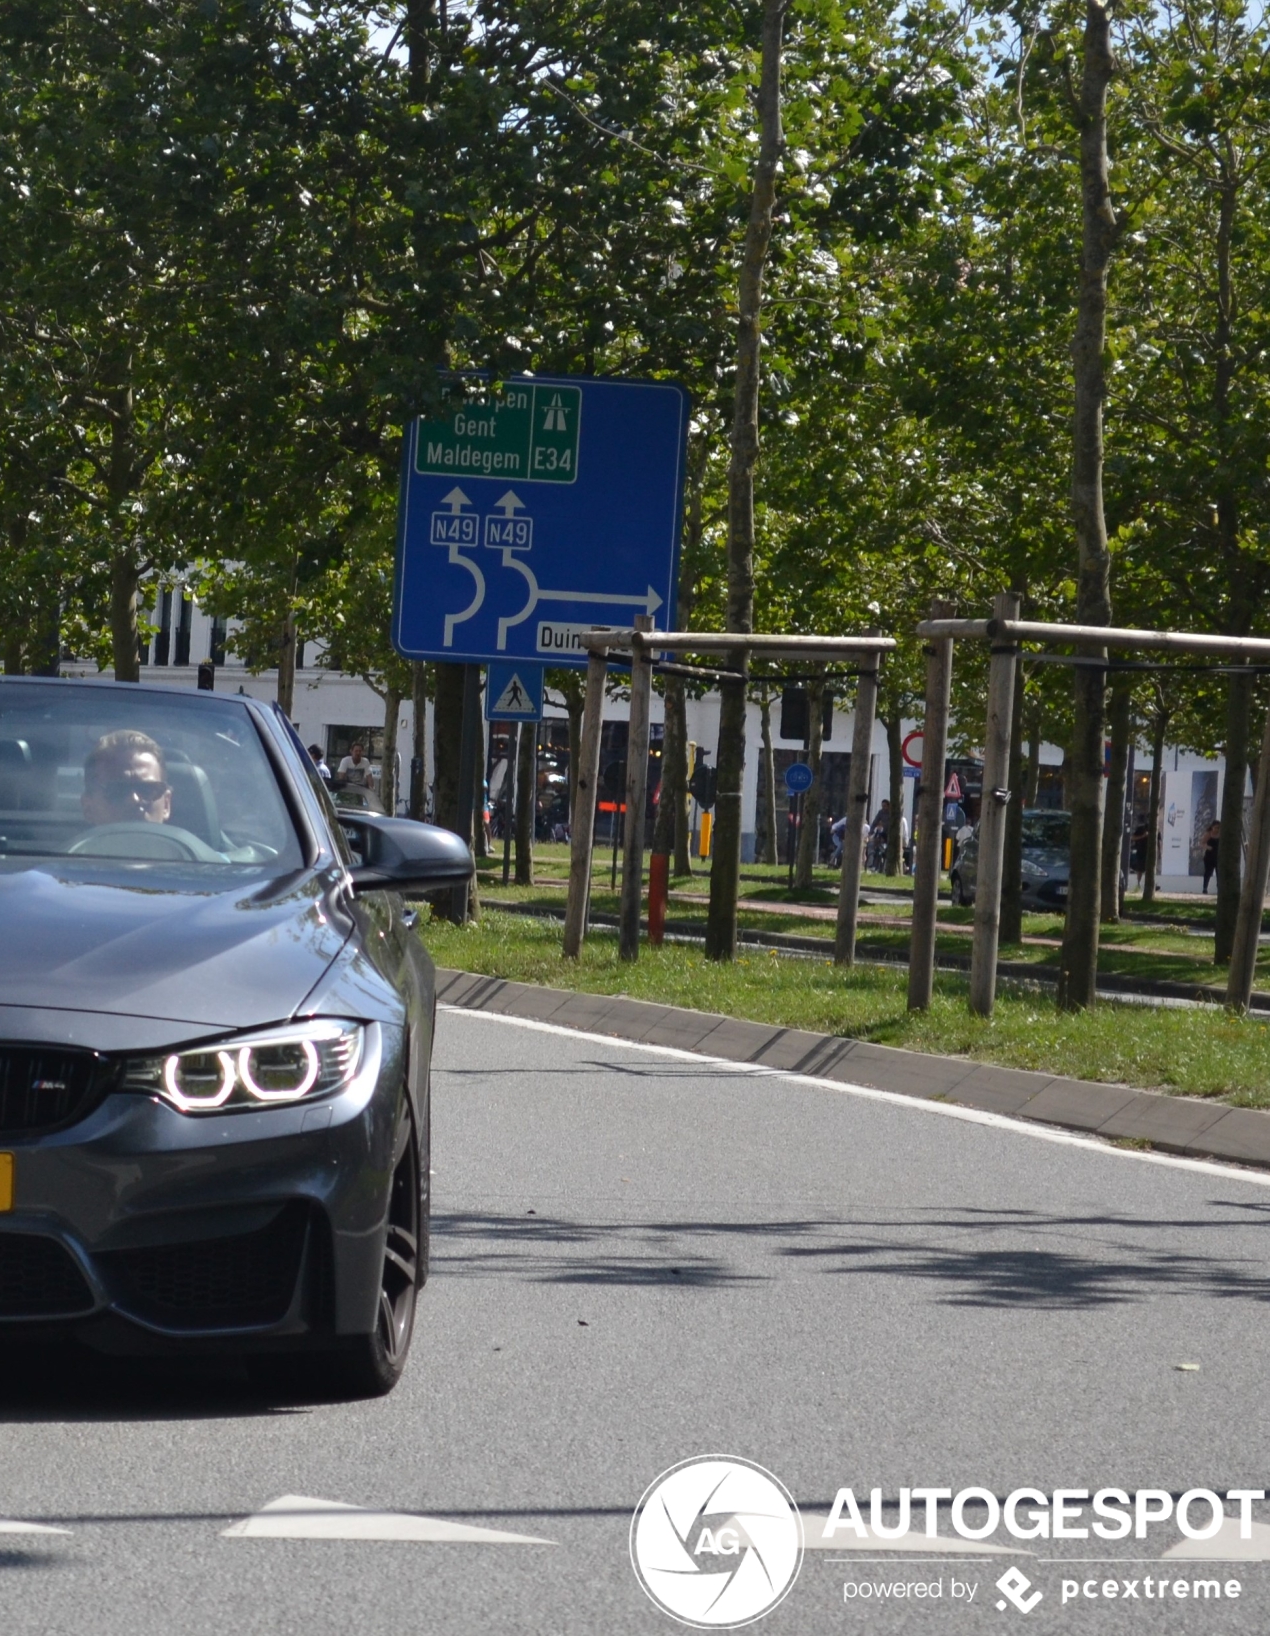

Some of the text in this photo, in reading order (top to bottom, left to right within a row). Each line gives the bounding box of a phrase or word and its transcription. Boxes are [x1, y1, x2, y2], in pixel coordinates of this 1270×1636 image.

[455, 413, 496, 438] Gent
[426, 442, 520, 473] Maldegem
[534, 447, 572, 471] E34
[436, 519, 473, 541] N49
[489, 522, 527, 545] N49
